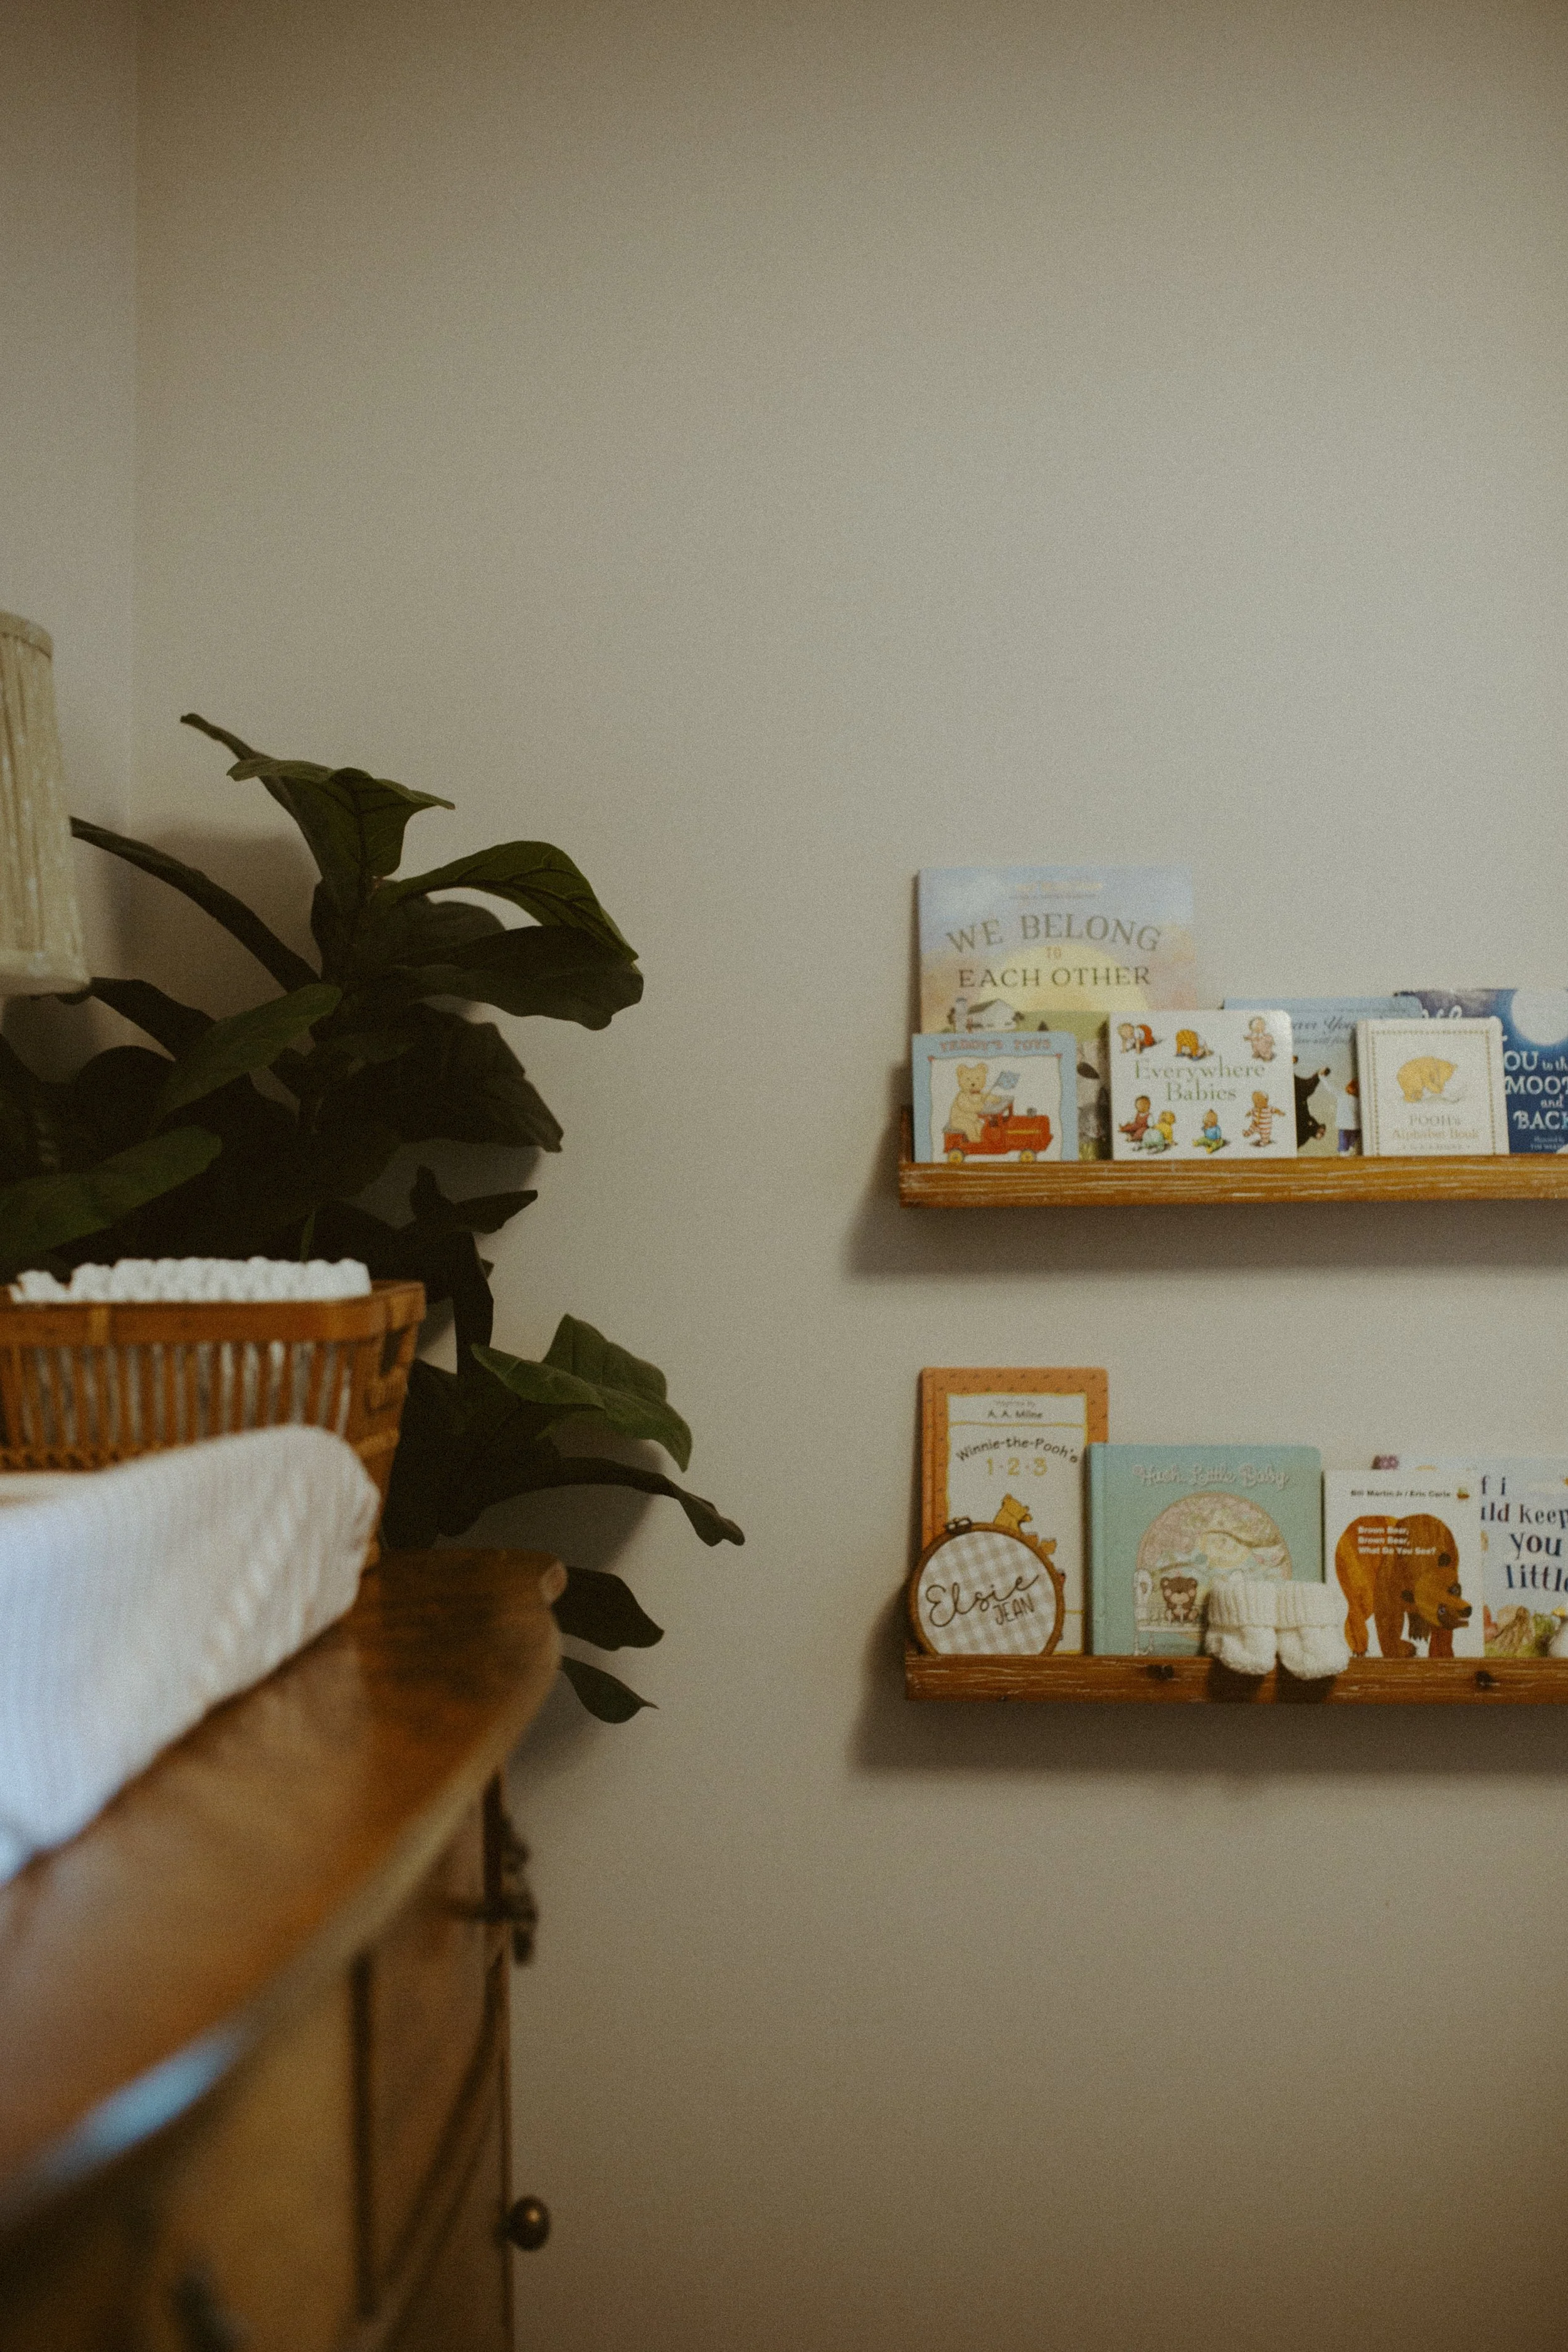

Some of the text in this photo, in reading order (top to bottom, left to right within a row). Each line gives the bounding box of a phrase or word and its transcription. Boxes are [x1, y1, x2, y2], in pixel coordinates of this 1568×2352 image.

[946, 913, 1162, 954] WE BELONG
[1046, 945, 1062, 960] TO
[958, 965, 1152, 988] EACH OTHER
[1133, 1054, 1266, 1083] Everywhere
[1503, 1049, 1568, 1072] OU to th
[1166, 1078, 1237, 1102] Babies
[1540, 1093, 1564, 1109] and
[1500, 1476, 1506, 1496] i
[1357, 1525, 1409, 1535] Brown Bear,
[1357, 1536, 1410, 1546] Brown Bear,
[1357, 1546, 1437, 1555] What Do You See?
[1509, 1532, 1562, 1560] you
[993, 1592, 1035, 1626] JEAN
